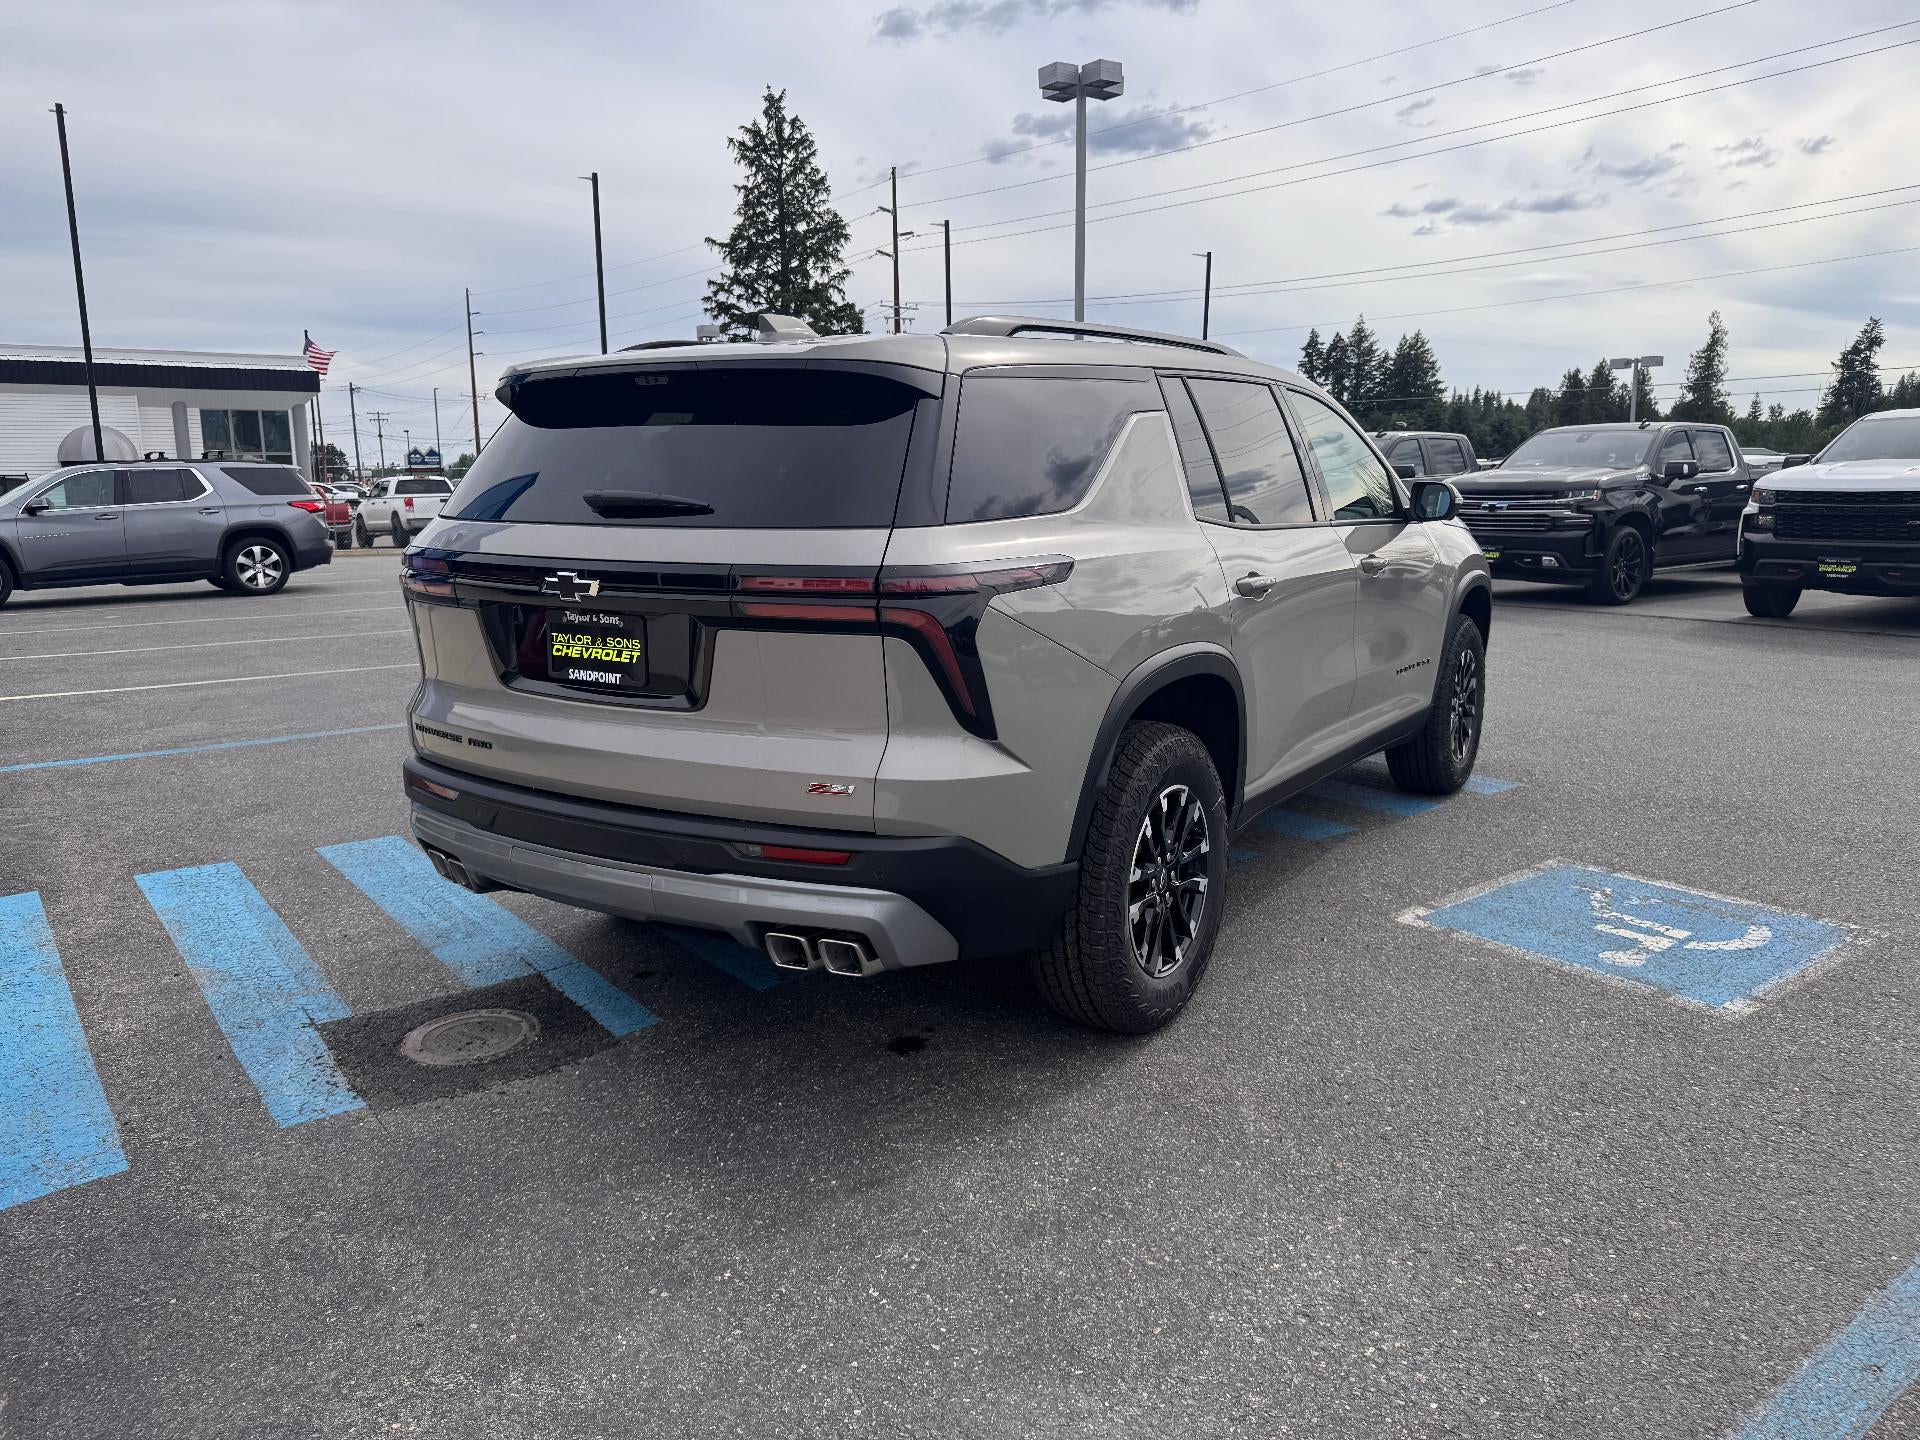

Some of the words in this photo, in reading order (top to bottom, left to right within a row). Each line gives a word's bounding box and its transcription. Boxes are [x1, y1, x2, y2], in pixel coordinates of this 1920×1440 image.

[565, 611, 591, 623] Taylor
[600, 614, 620, 624] Sons
[551, 633, 592, 645] TAYLOR
[596, 638, 603, 648] &
[607, 637, 640, 649] SONS
[552, 645, 641, 663] CHEVROLET
[568, 668, 622, 684] SANDPOINT
[415, 722, 463, 743] TRAVERSE
